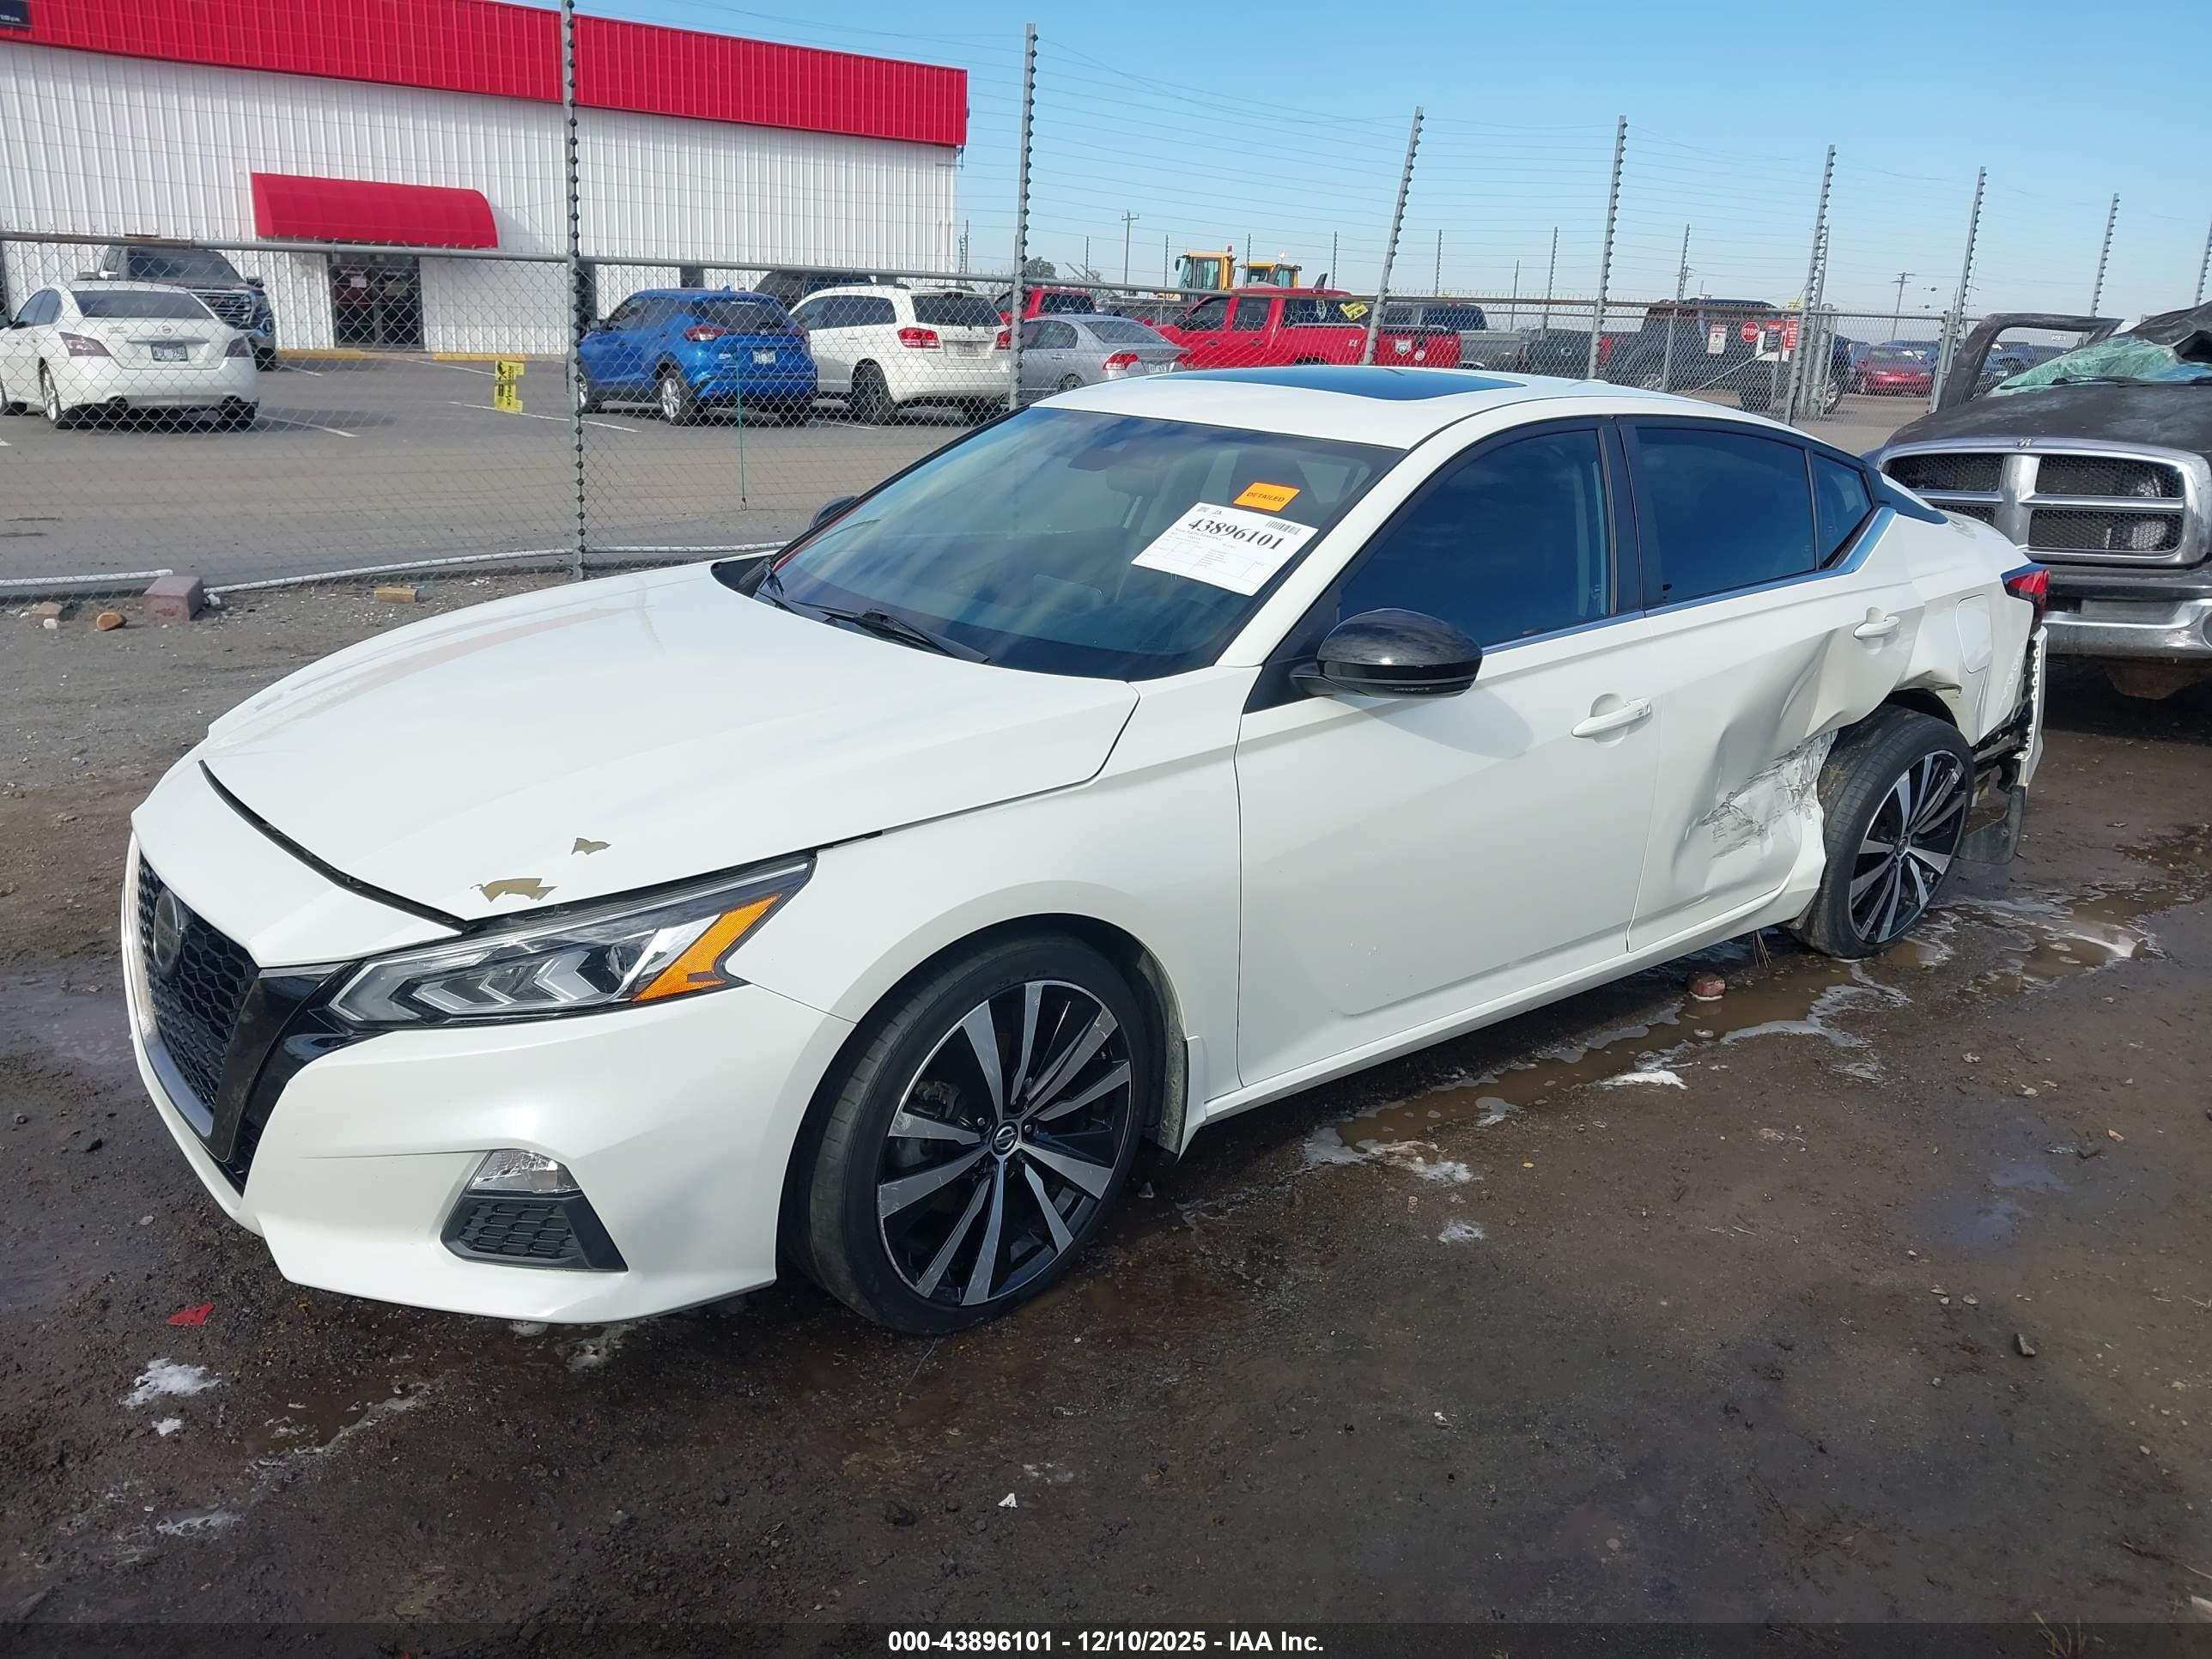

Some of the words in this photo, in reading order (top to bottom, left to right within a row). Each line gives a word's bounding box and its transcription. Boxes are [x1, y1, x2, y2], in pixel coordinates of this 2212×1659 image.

[1742, 328, 1759, 337] STOP
[1246, 491, 1285, 502] DETAILED
[1188, 518, 1285, 550] 43896101
